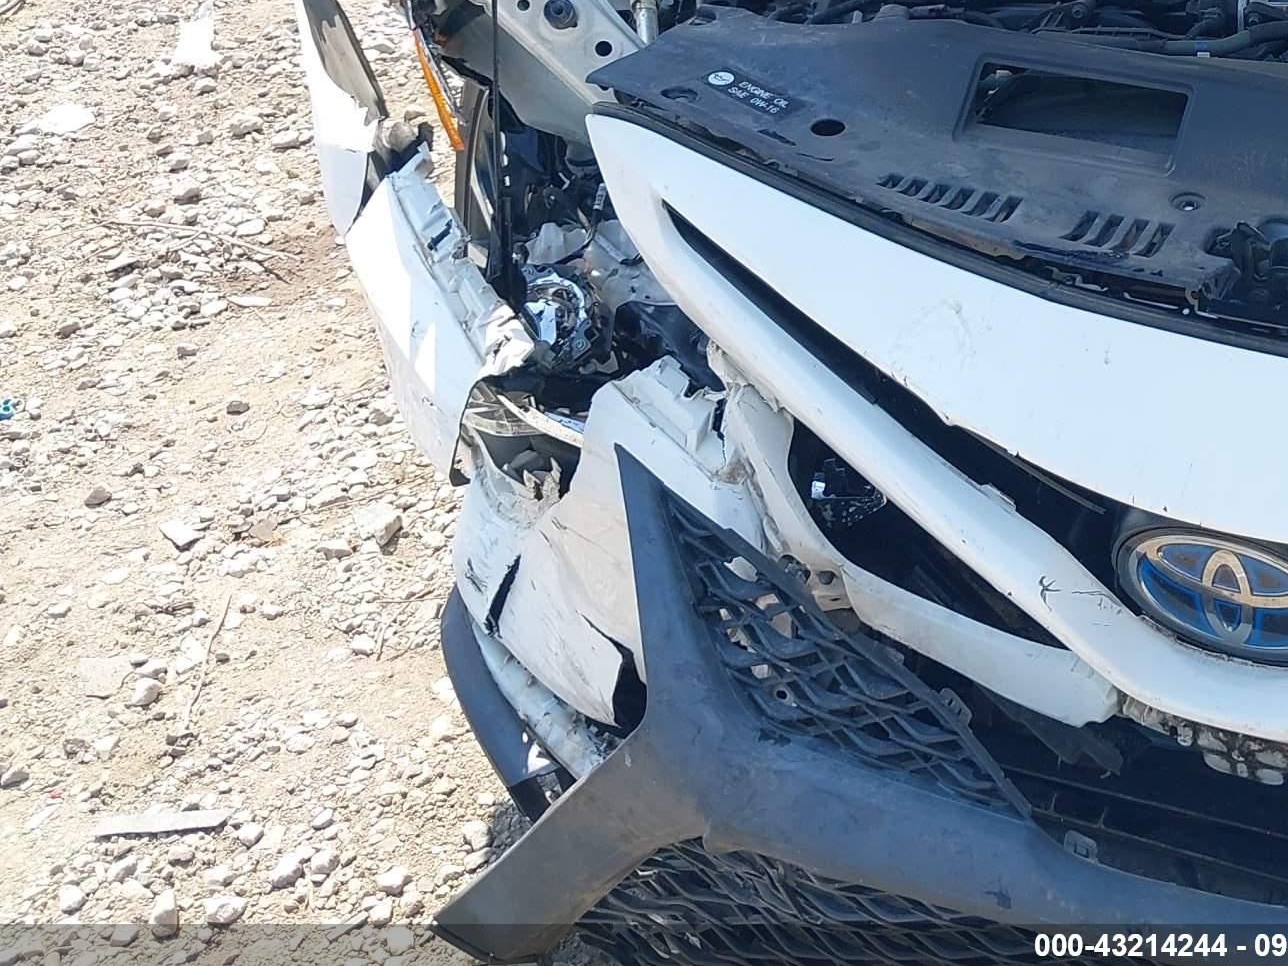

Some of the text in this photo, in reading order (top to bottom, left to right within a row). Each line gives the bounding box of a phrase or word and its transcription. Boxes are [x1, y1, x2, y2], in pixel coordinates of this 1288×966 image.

[727, 86, 780, 114] SAE 0W-16
[738, 81, 790, 109] ENGINE OIL
